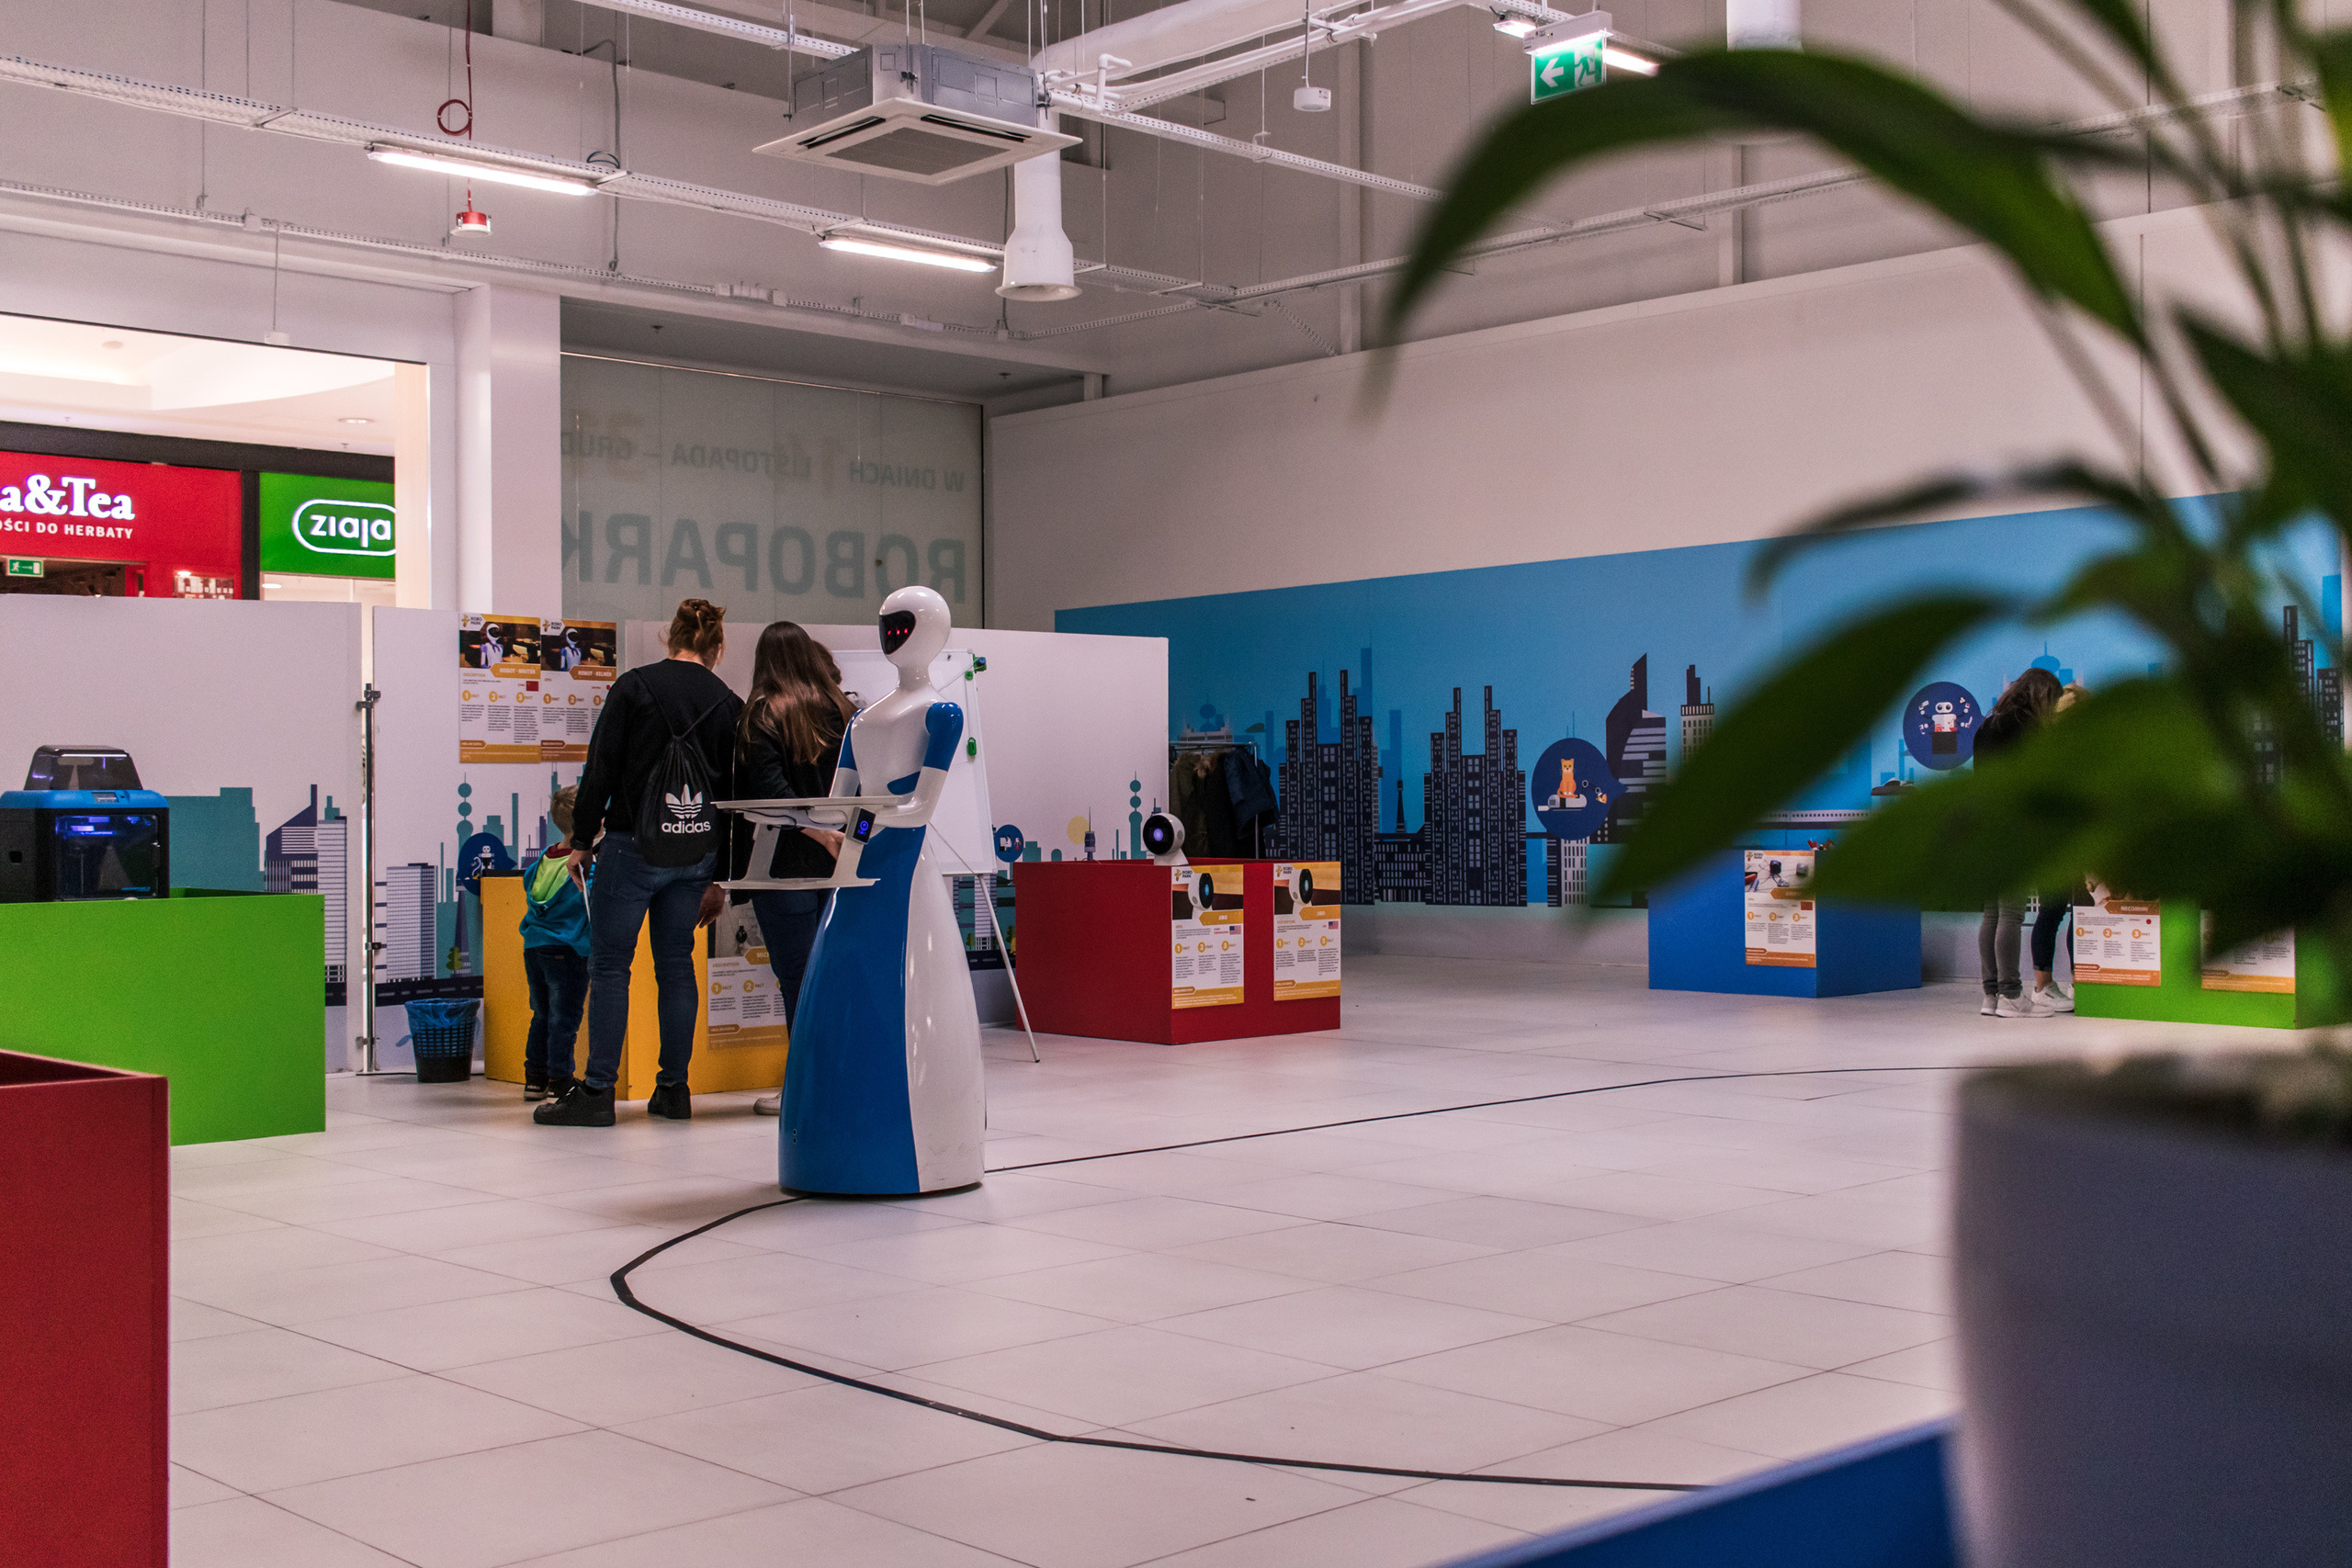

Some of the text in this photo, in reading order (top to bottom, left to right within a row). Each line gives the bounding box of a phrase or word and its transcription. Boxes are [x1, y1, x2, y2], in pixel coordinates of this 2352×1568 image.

[0, 474, 136, 520] a&Tea
[36, 522, 58, 534] DO
[64, 524, 133, 539] HERBATY
[310, 514, 391, 547] ziaja
[662, 820, 711, 833] adidas
